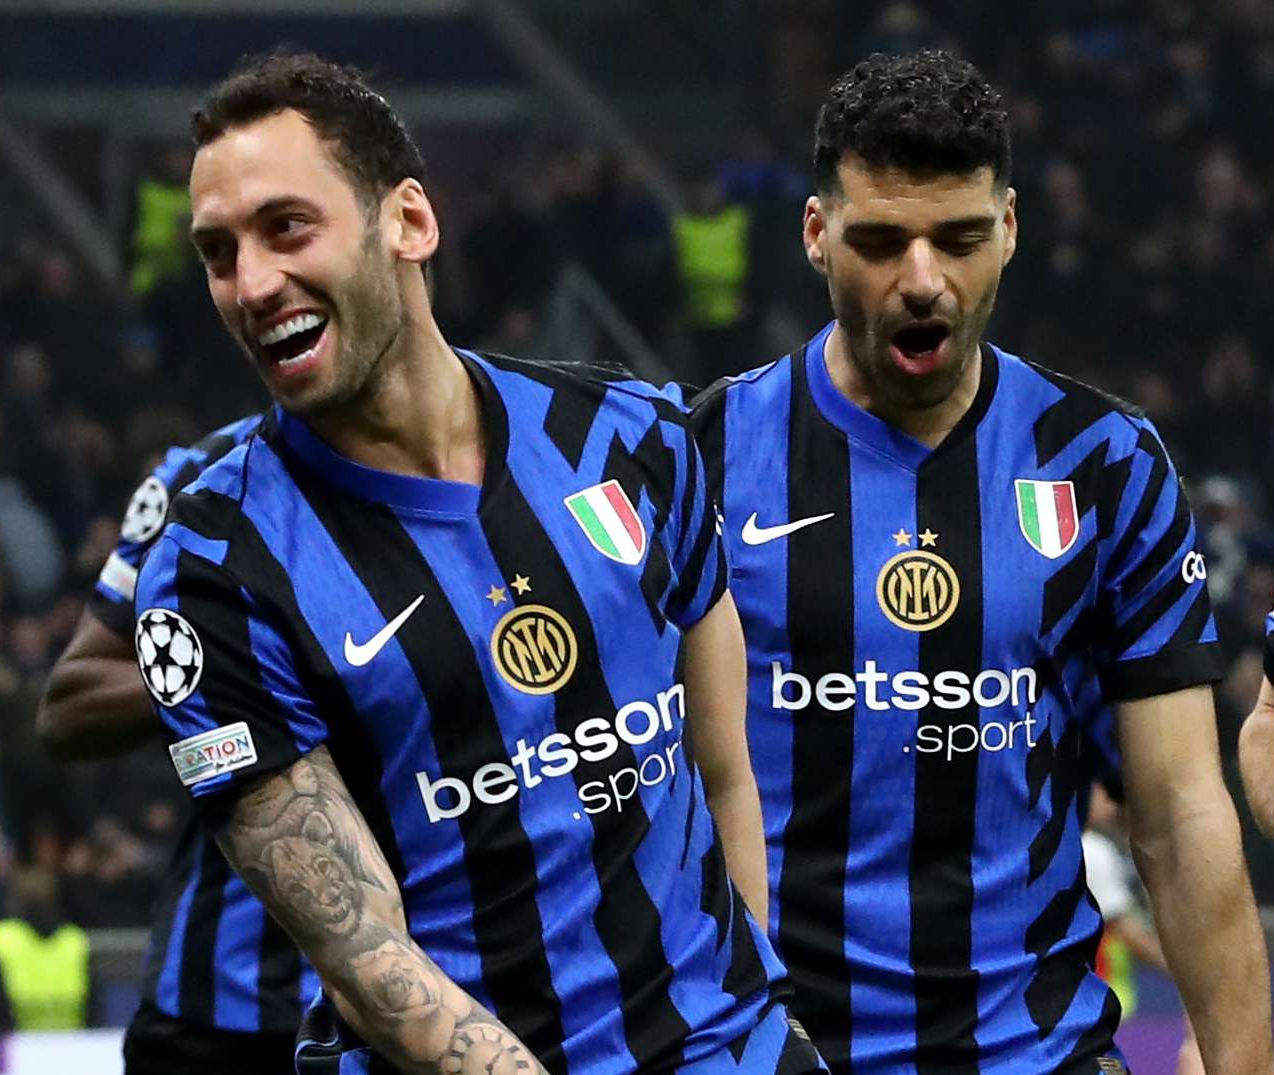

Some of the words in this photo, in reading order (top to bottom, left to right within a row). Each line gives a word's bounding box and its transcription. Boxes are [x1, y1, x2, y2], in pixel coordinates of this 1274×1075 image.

[771, 660, 1037, 712] betsson
[416, 683, 685, 823] betsson
[902, 711, 1037, 762] .sport
[573, 727, 683, 821] .spor
